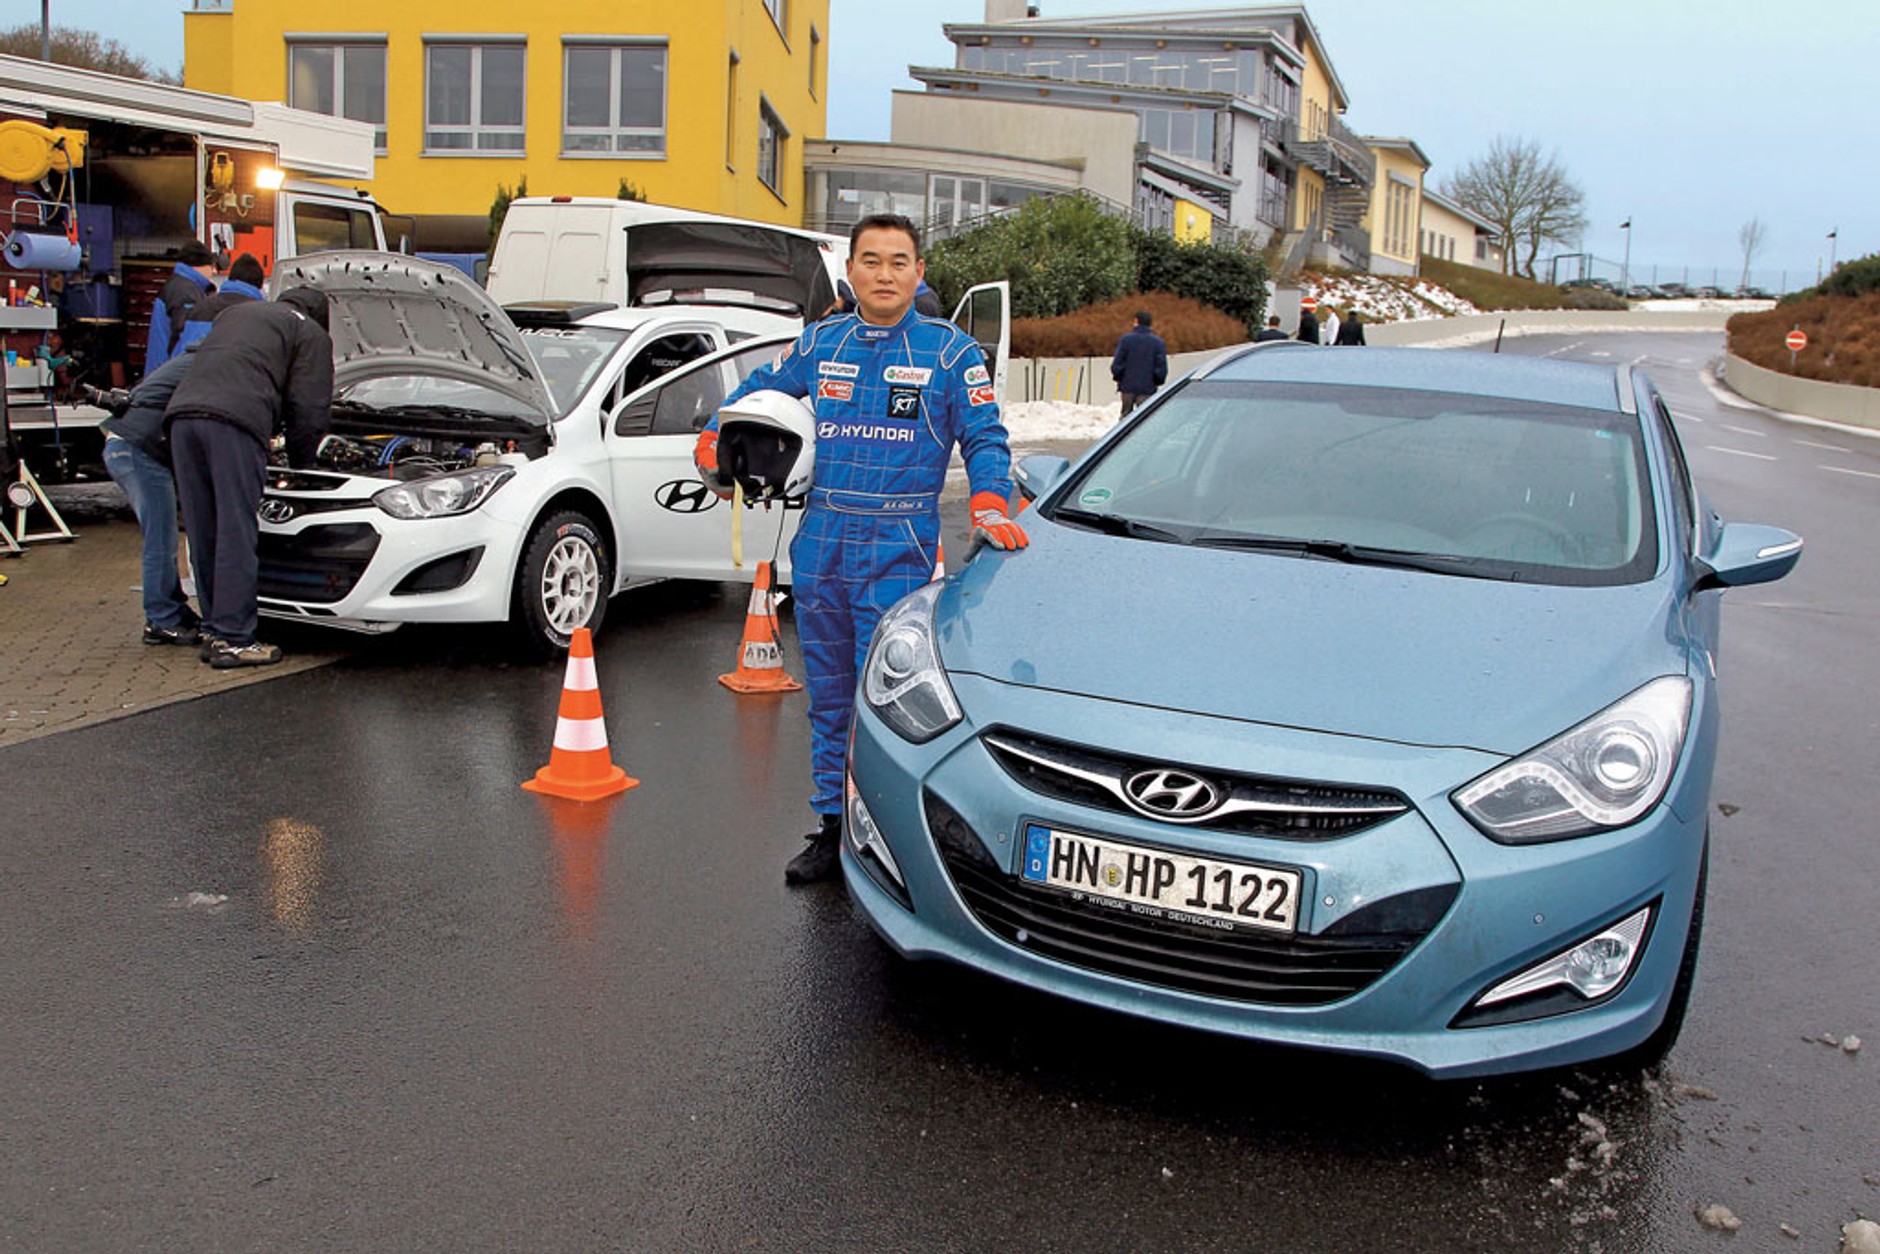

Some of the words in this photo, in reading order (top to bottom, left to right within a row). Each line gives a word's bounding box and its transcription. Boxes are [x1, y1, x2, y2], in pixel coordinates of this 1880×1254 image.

[840, 424, 915, 442] HYUNDAI
[1051, 836, 1101, 887] HN
[1124, 852, 1176, 899] HP
[1185, 864, 1290, 923] 1122
[1088, 896, 1126, 910] HYUNDAI
[1131, 903, 1163, 917] MOTOR
[1167, 911, 1234, 931] DEUTSCHLAND
